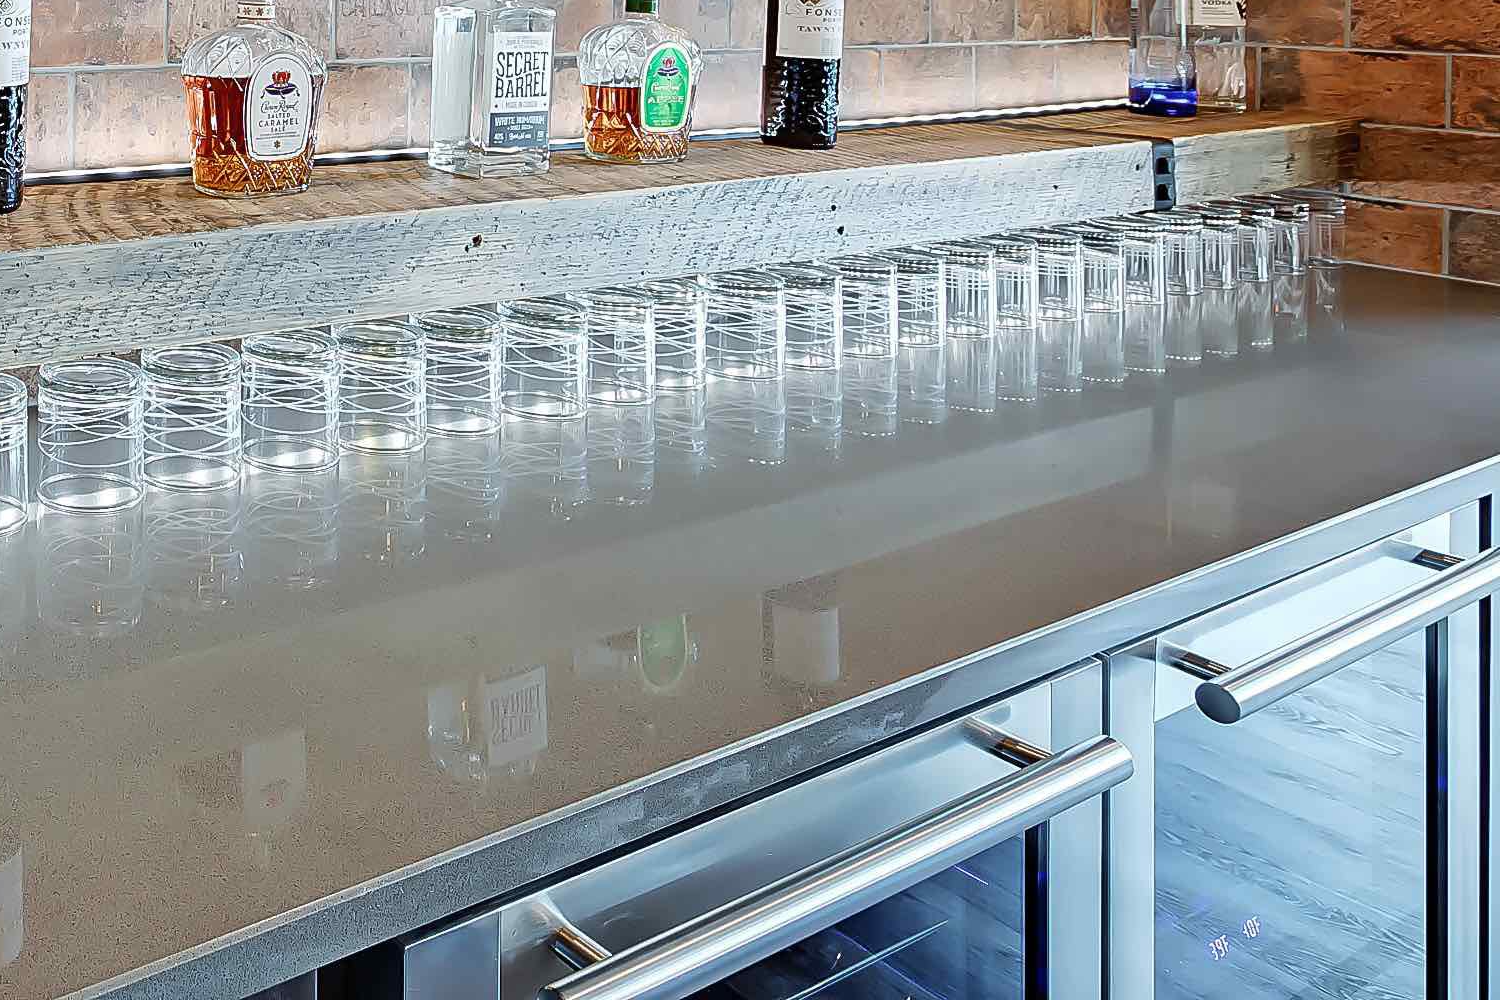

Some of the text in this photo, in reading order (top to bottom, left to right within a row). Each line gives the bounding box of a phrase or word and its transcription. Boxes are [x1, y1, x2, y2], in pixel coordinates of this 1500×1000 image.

[496, 51, 549, 78] SECRET
[494, 71, 548, 98] BARREL
[258, 117, 300, 128] CARAMEL
